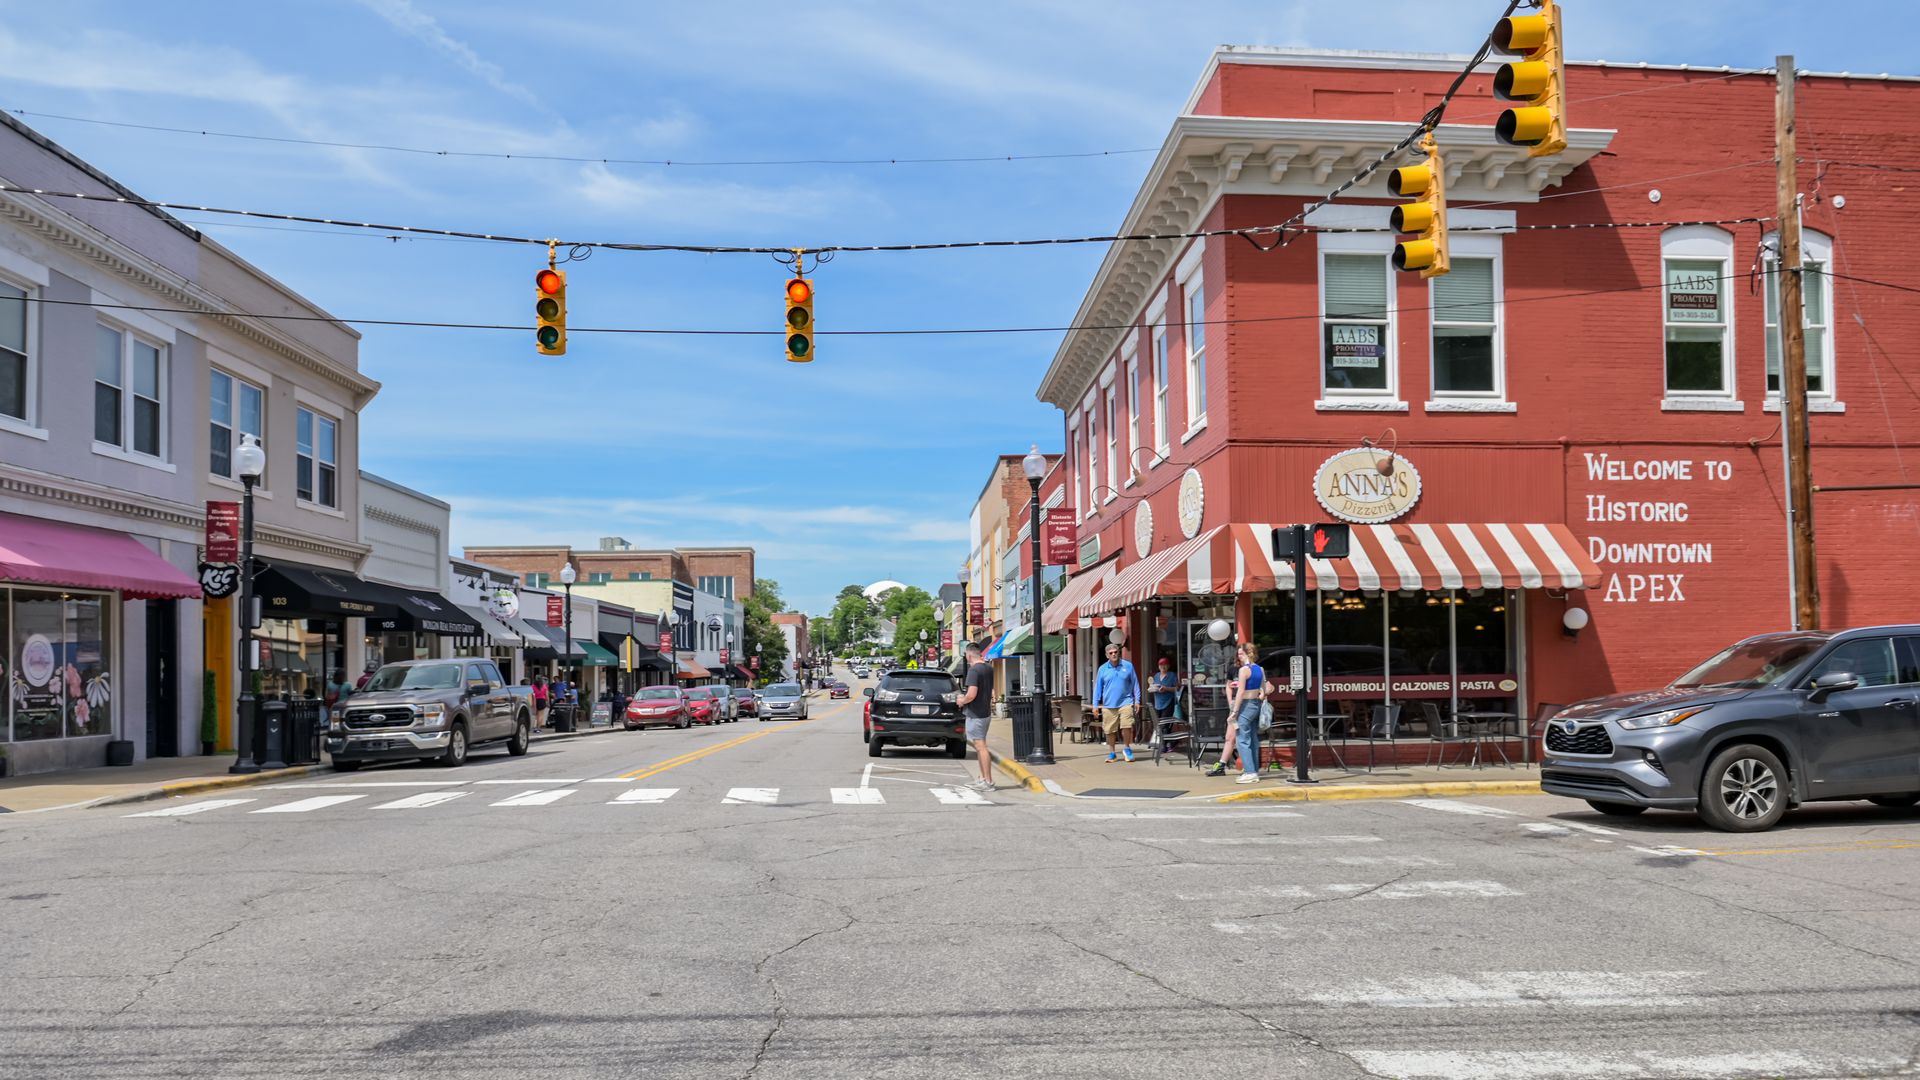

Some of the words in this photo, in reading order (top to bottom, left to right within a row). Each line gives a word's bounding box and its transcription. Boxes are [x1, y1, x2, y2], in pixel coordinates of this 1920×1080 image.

[1673, 274, 1714, 290] AABS
[1673, 295, 1715, 303] PROACTIVE
[1336, 328, 1376, 343] AABS
[1335, 345, 1376, 353] PROACTIVE
[1704, 461, 1732, 480] TO
[1328, 471, 1408, 498] ANNA'S
[1603, 573, 1685, 602] APEX
[272, 597, 287, 605] 103
[382, 621, 396, 629] 105
[1322, 682, 1386, 692] STROMBOLI
[1392, 682, 1450, 691] CALZONES
[1460, 681, 1495, 690] PASTA
